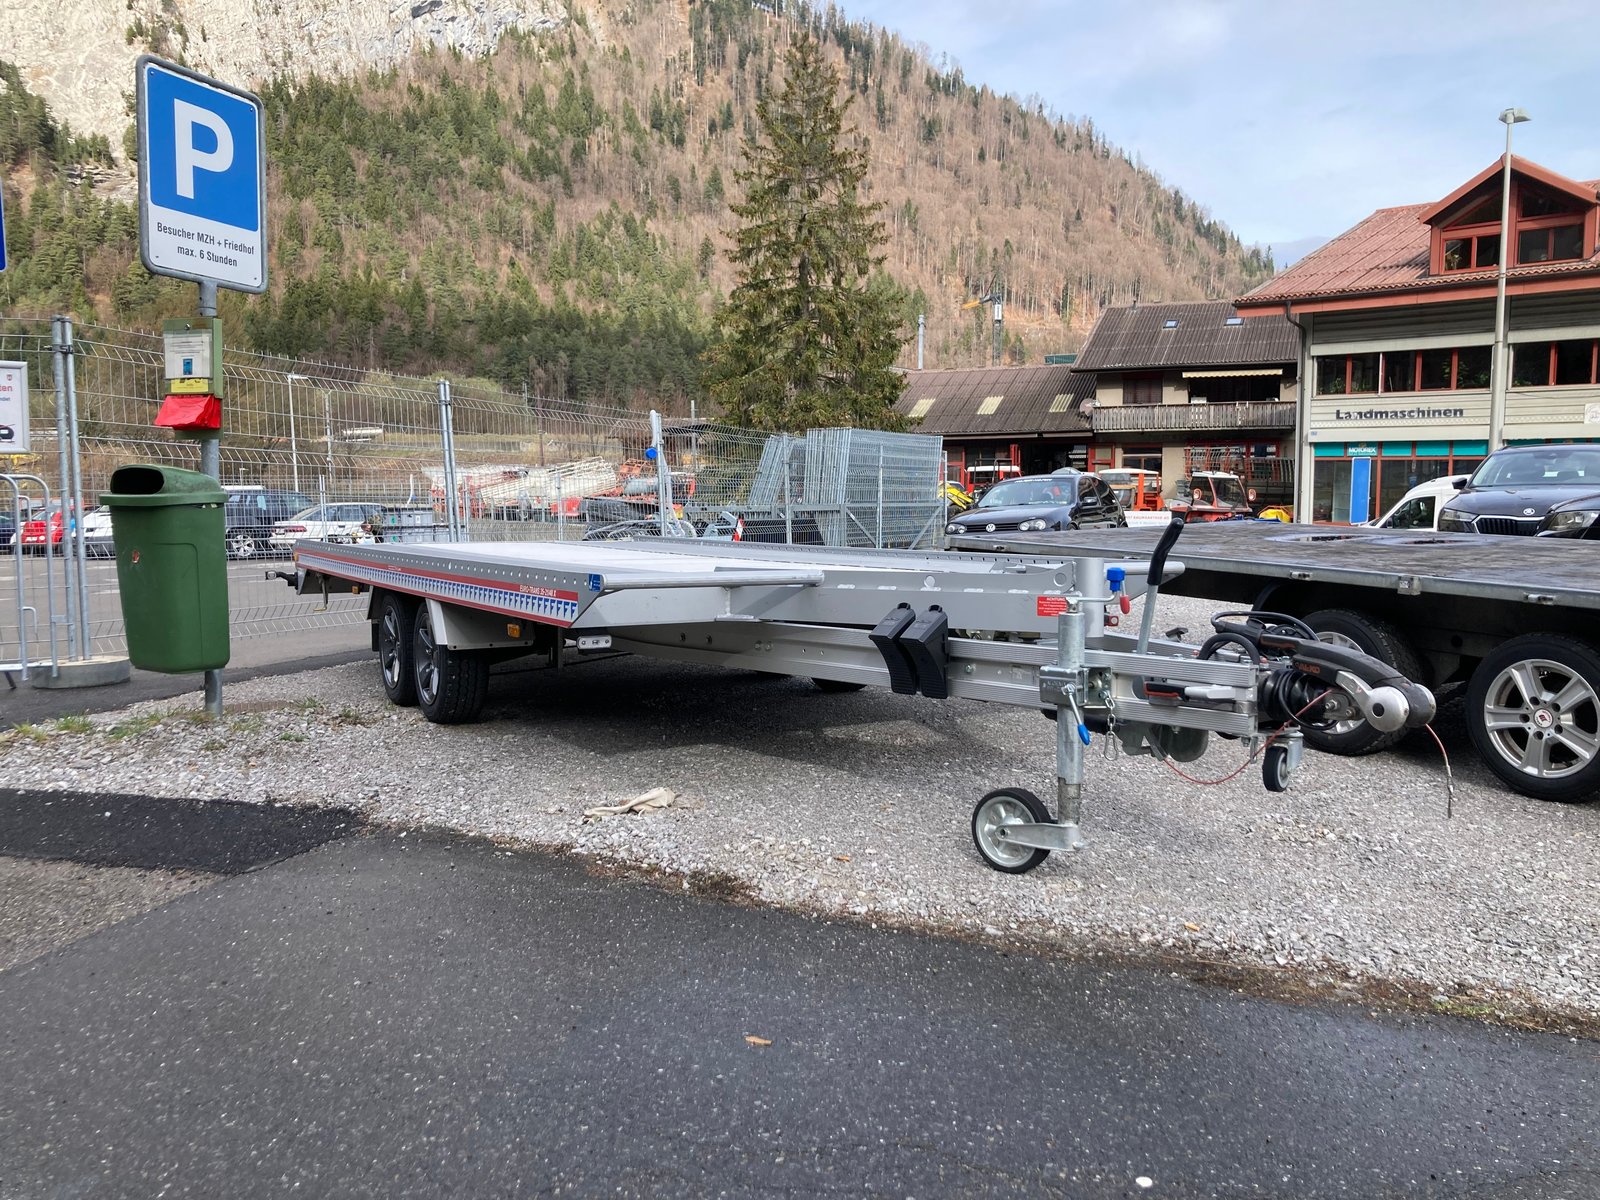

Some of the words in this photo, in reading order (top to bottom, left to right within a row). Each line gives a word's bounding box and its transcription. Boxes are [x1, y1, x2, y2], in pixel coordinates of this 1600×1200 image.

[173, 98, 234, 200] P
[157, 221, 195, 240] Besucher
[197, 231, 215, 246] MZH
[223, 238, 255, 255] Friedhof
[177, 245, 197, 258] max.
[199, 249, 205, 260] 6
[206, 250, 238, 267] Stunden
[1335, 407, 1464, 420] Landmaschinen
